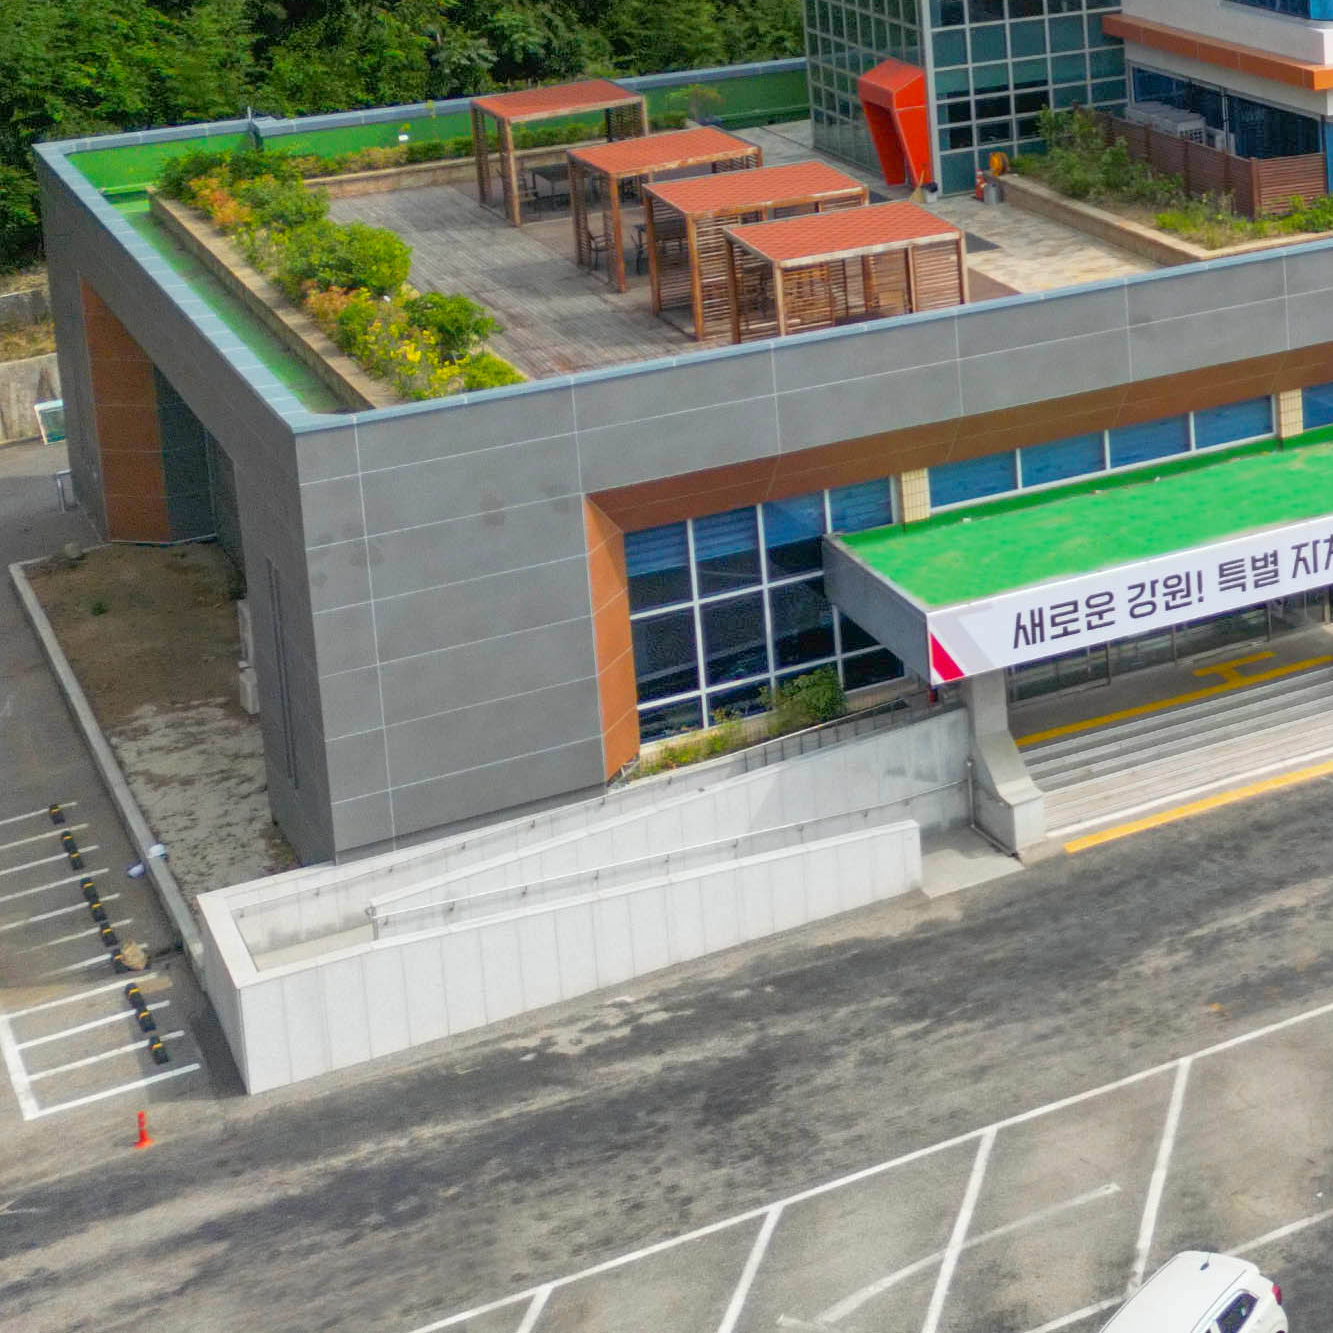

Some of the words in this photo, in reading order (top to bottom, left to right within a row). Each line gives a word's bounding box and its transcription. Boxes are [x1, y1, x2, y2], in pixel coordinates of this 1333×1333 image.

[1012, 590, 1116, 650] 새로운
[1127, 569, 1205, 620] 강원!
[1218, 548, 1280, 594] 특별
